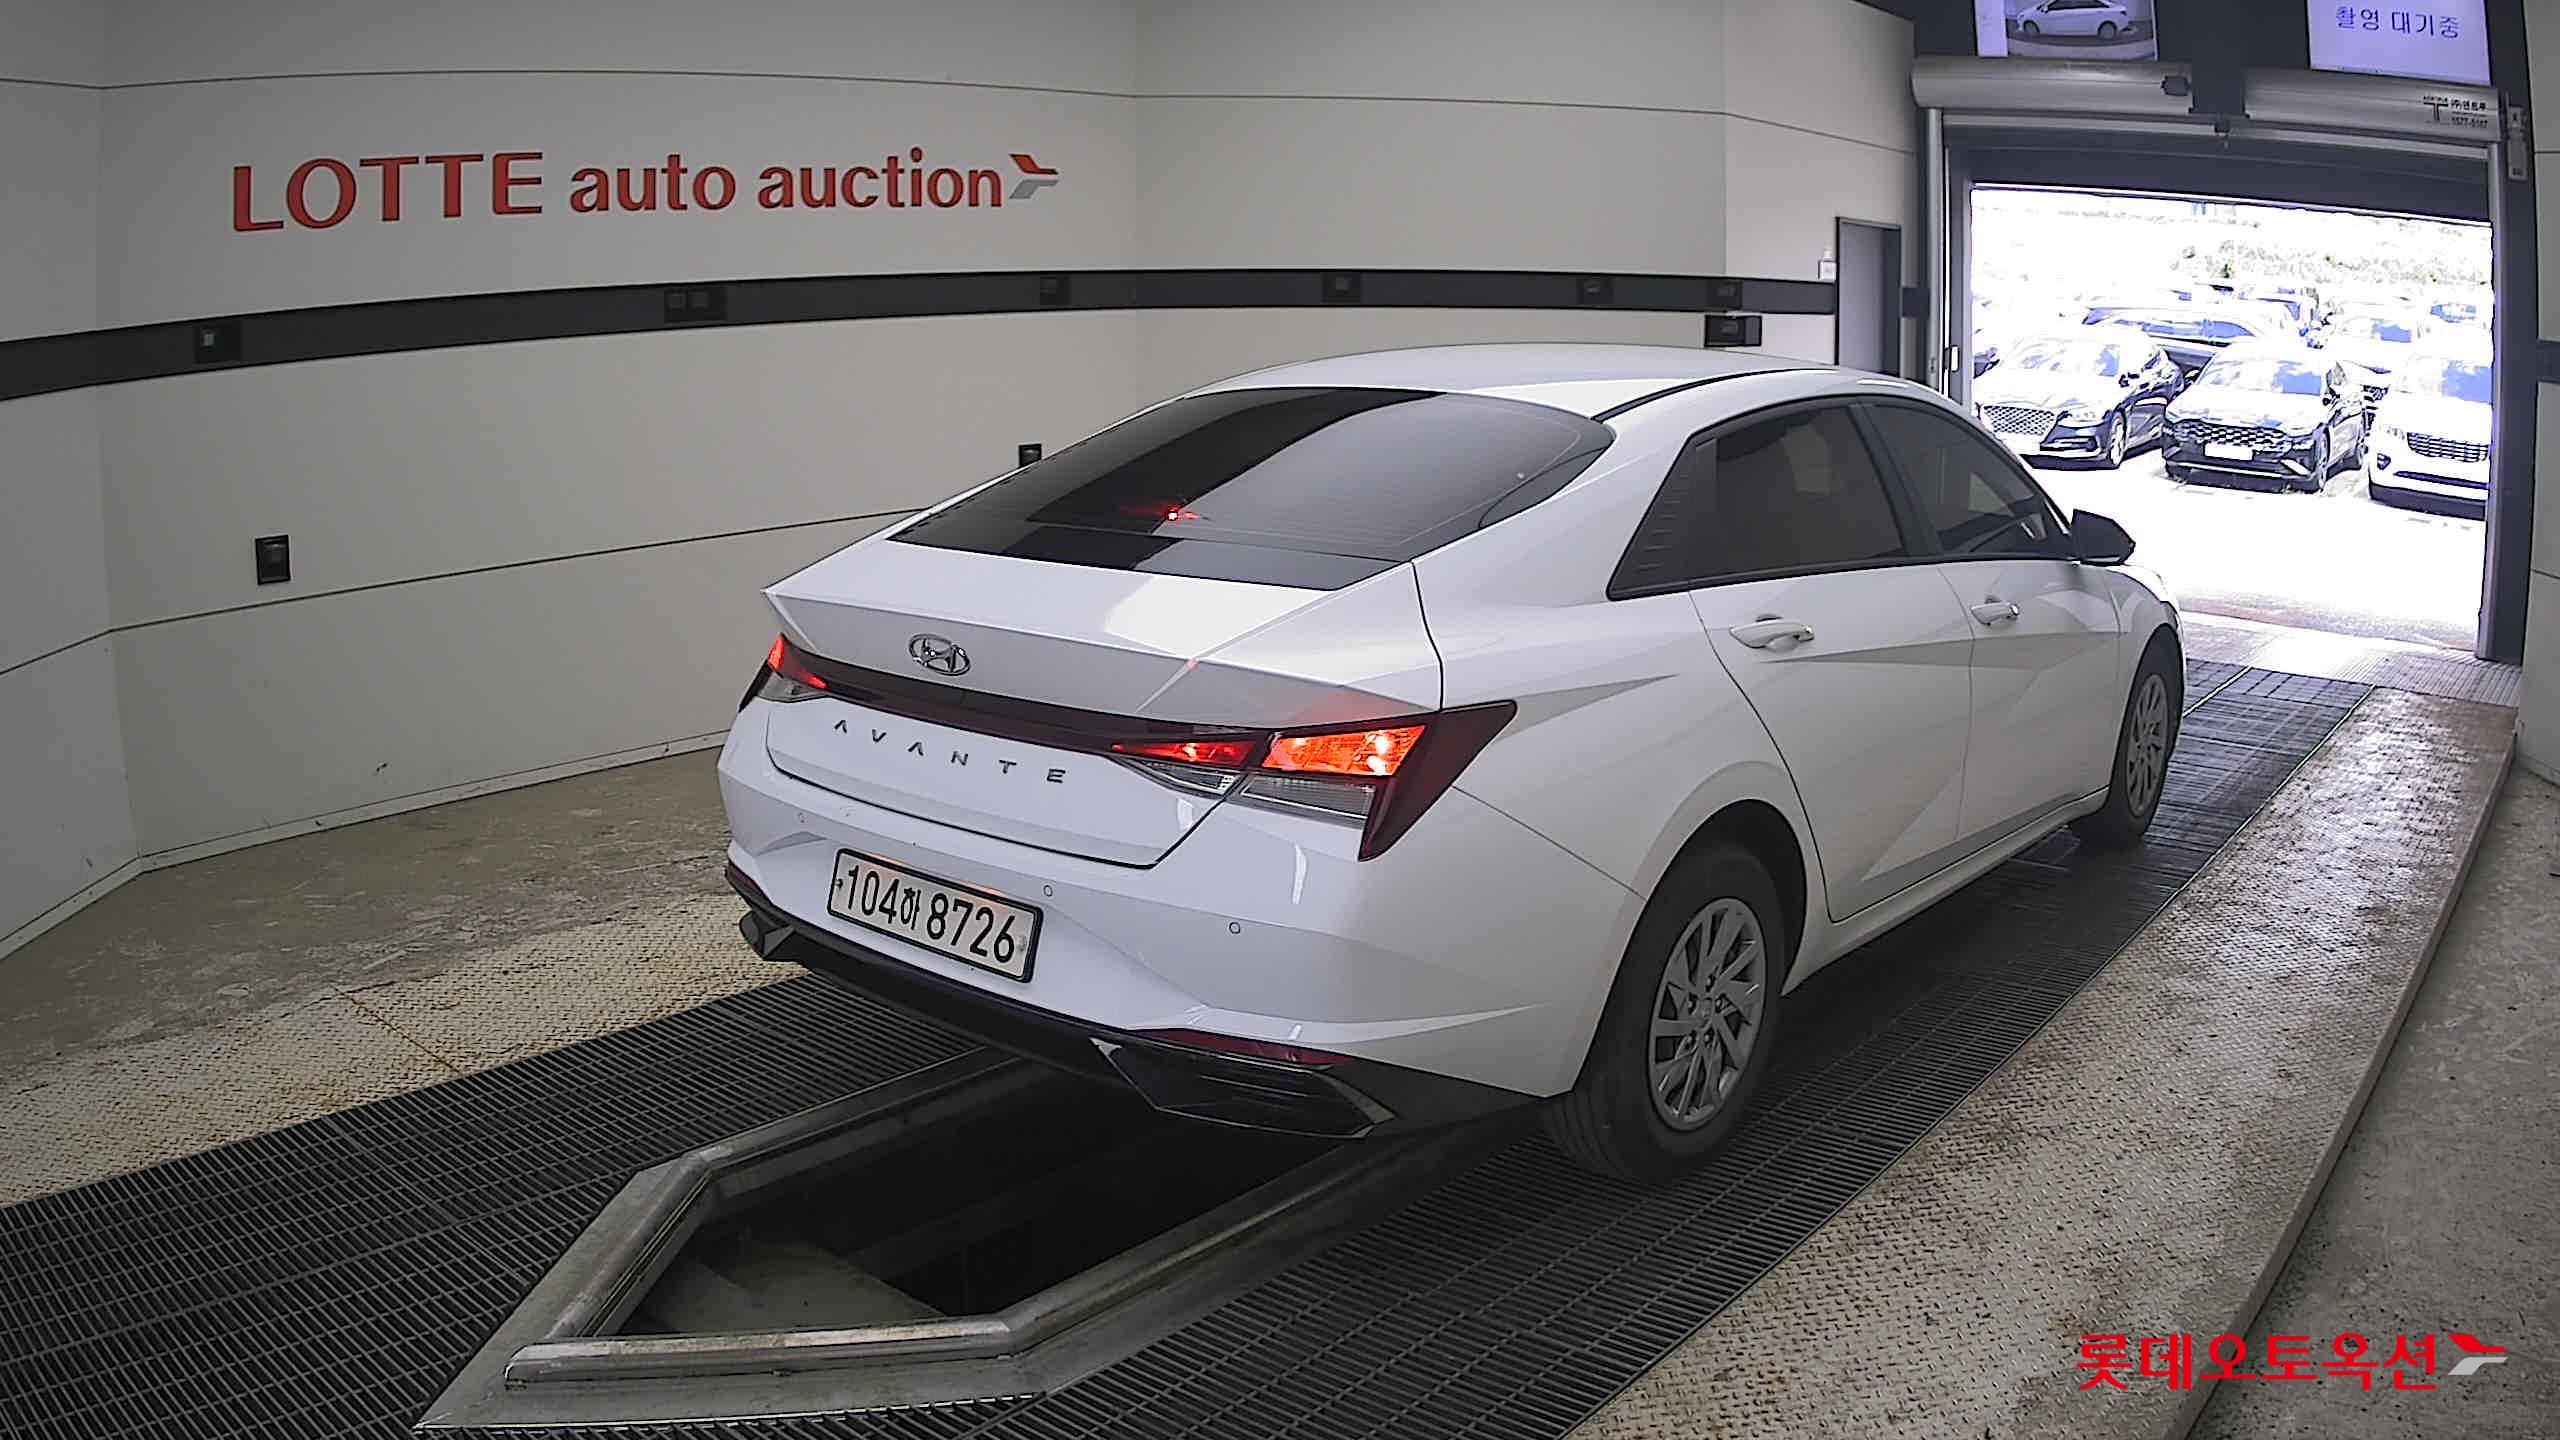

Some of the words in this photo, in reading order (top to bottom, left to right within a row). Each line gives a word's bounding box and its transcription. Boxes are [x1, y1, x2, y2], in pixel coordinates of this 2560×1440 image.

[2336, 5, 2380, 31] 촬영
[2391, 11, 2460, 39] 대기중
[232, 151, 544, 233] LOTTE
[568, 154, 737, 213] auto
[757, 146, 1003, 209] auction
[833, 719, 1067, 784] AVANTE
